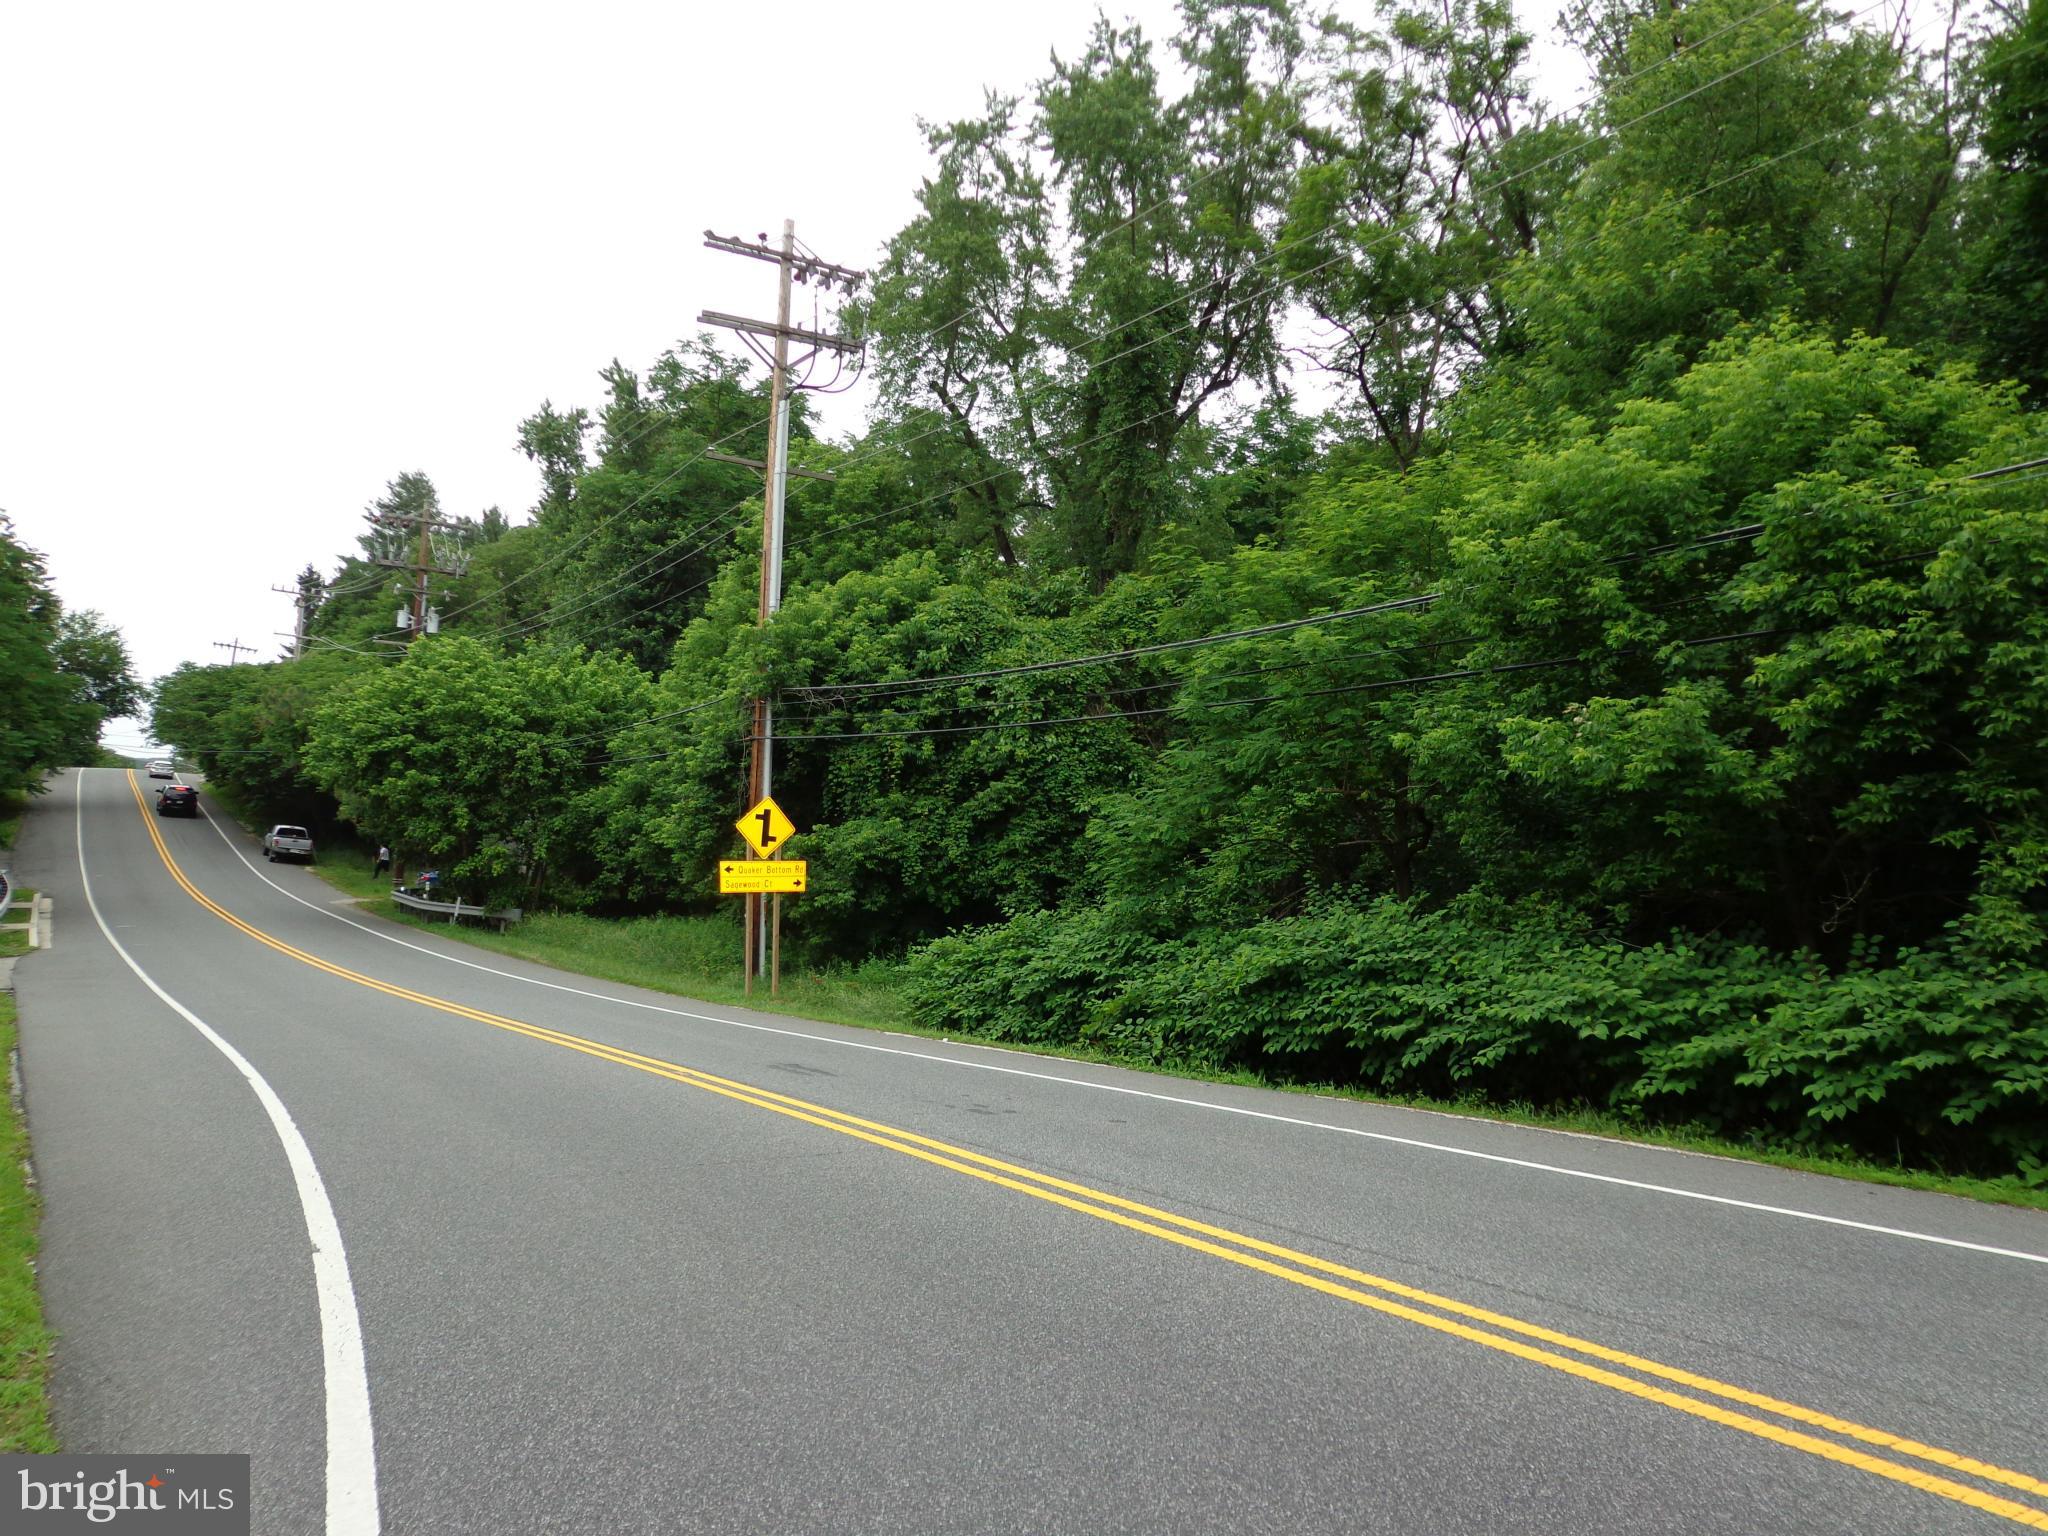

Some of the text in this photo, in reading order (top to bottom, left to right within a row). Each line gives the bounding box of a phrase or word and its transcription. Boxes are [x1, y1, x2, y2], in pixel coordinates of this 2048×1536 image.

[738, 865, 804, 874] Quaker Bottom Rd
[725, 879, 773, 889] Sagewood Ct
